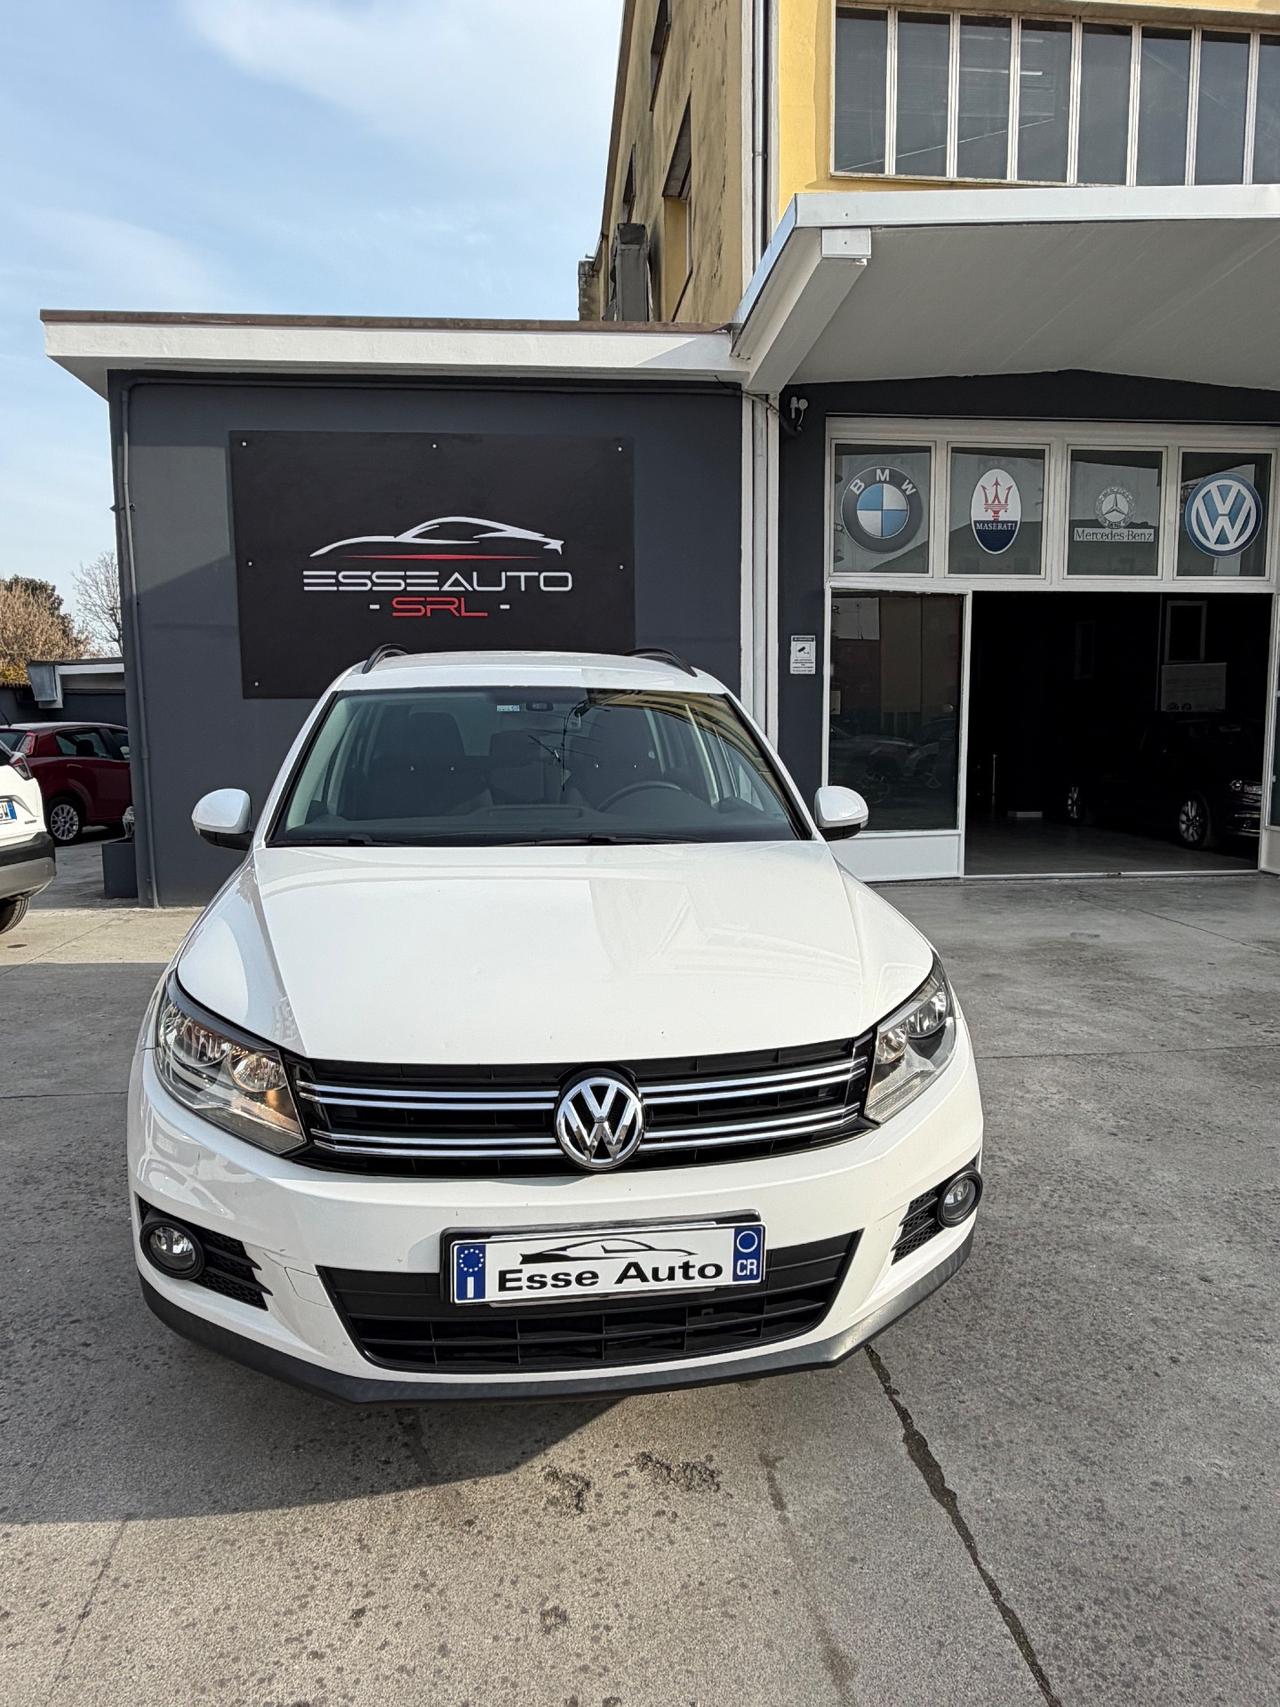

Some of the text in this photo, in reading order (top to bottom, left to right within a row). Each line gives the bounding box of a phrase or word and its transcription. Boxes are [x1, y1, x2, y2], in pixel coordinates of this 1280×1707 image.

[849, 468, 917, 496] BMW
[975, 522, 1016, 531] MASERATI
[302, 570, 573, 592] ESSEAUTO
[391, 596, 489, 617] SRL
[498, 1259, 724, 1293] Esse Auto
[736, 1258, 758, 1276] CR
